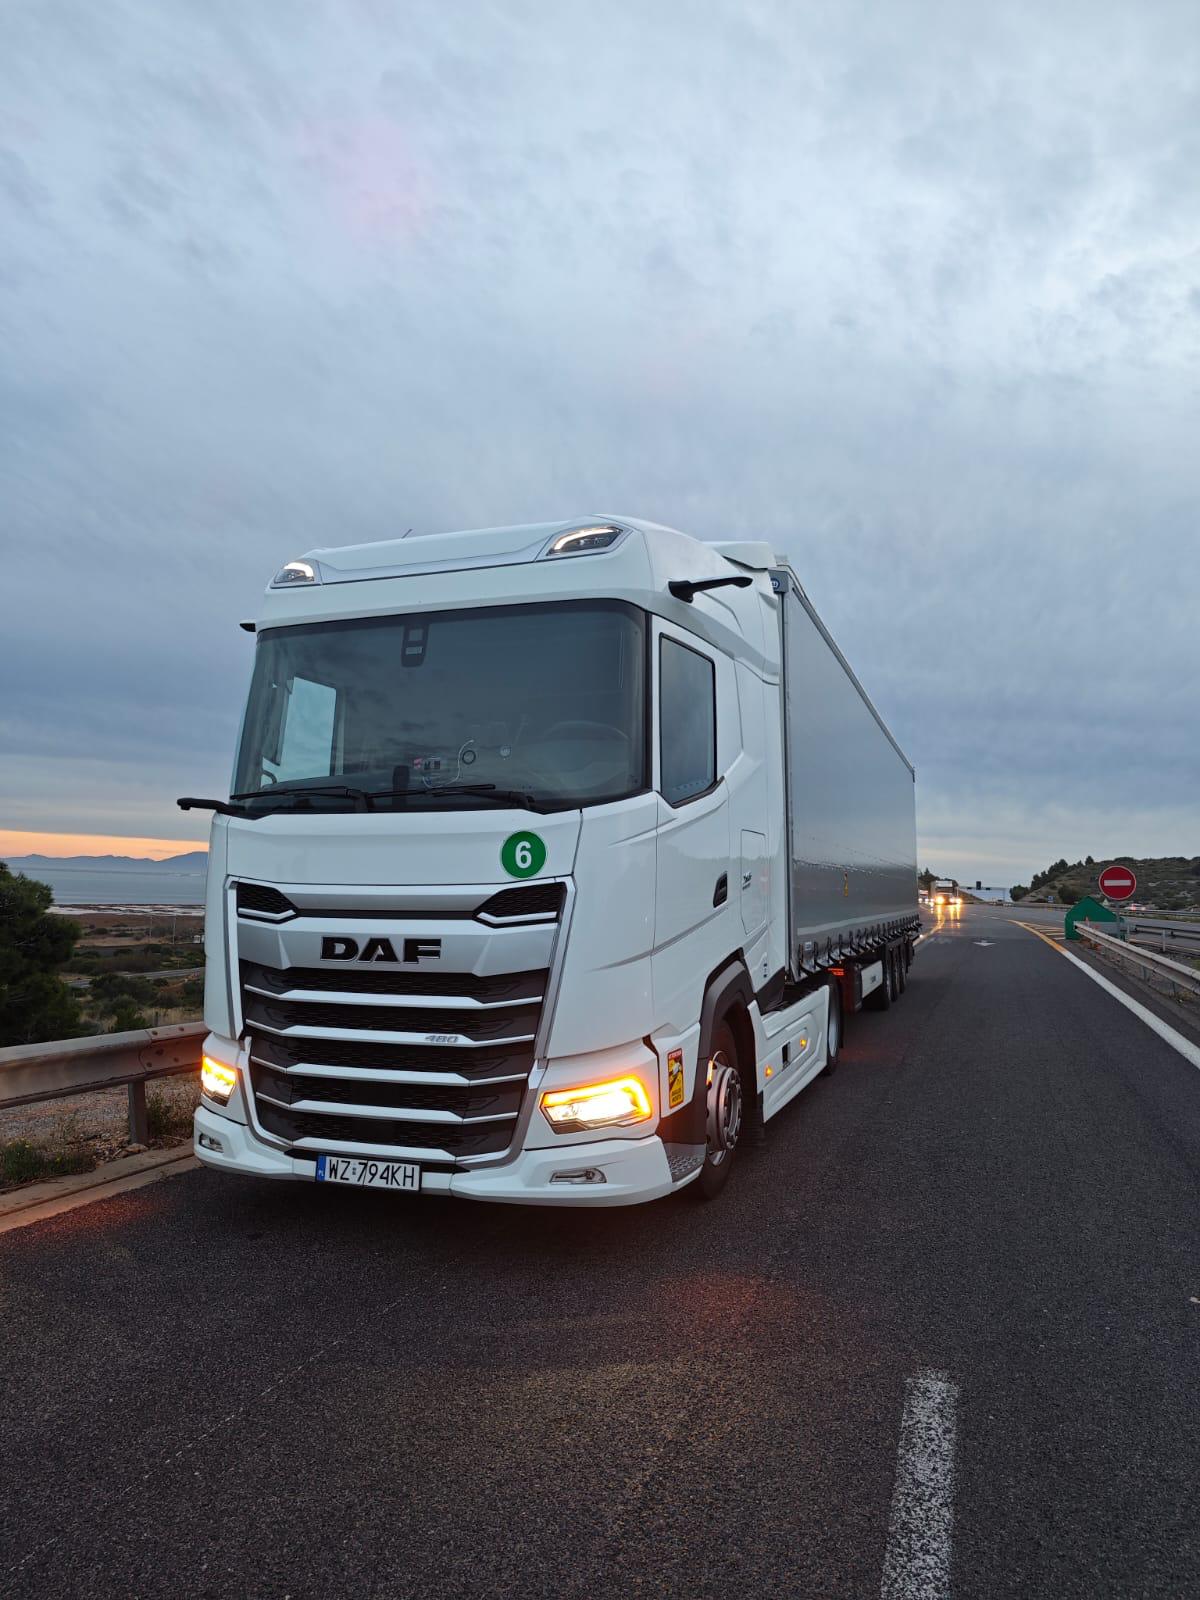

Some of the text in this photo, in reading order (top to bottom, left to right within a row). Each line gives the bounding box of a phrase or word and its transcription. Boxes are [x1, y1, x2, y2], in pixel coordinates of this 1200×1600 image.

[515, 841, 532, 868] 6
[319, 936, 441, 964] DAF
[425, 1035, 459, 1045] 480
[329, 1159, 415, 1188] WZ 794KH
